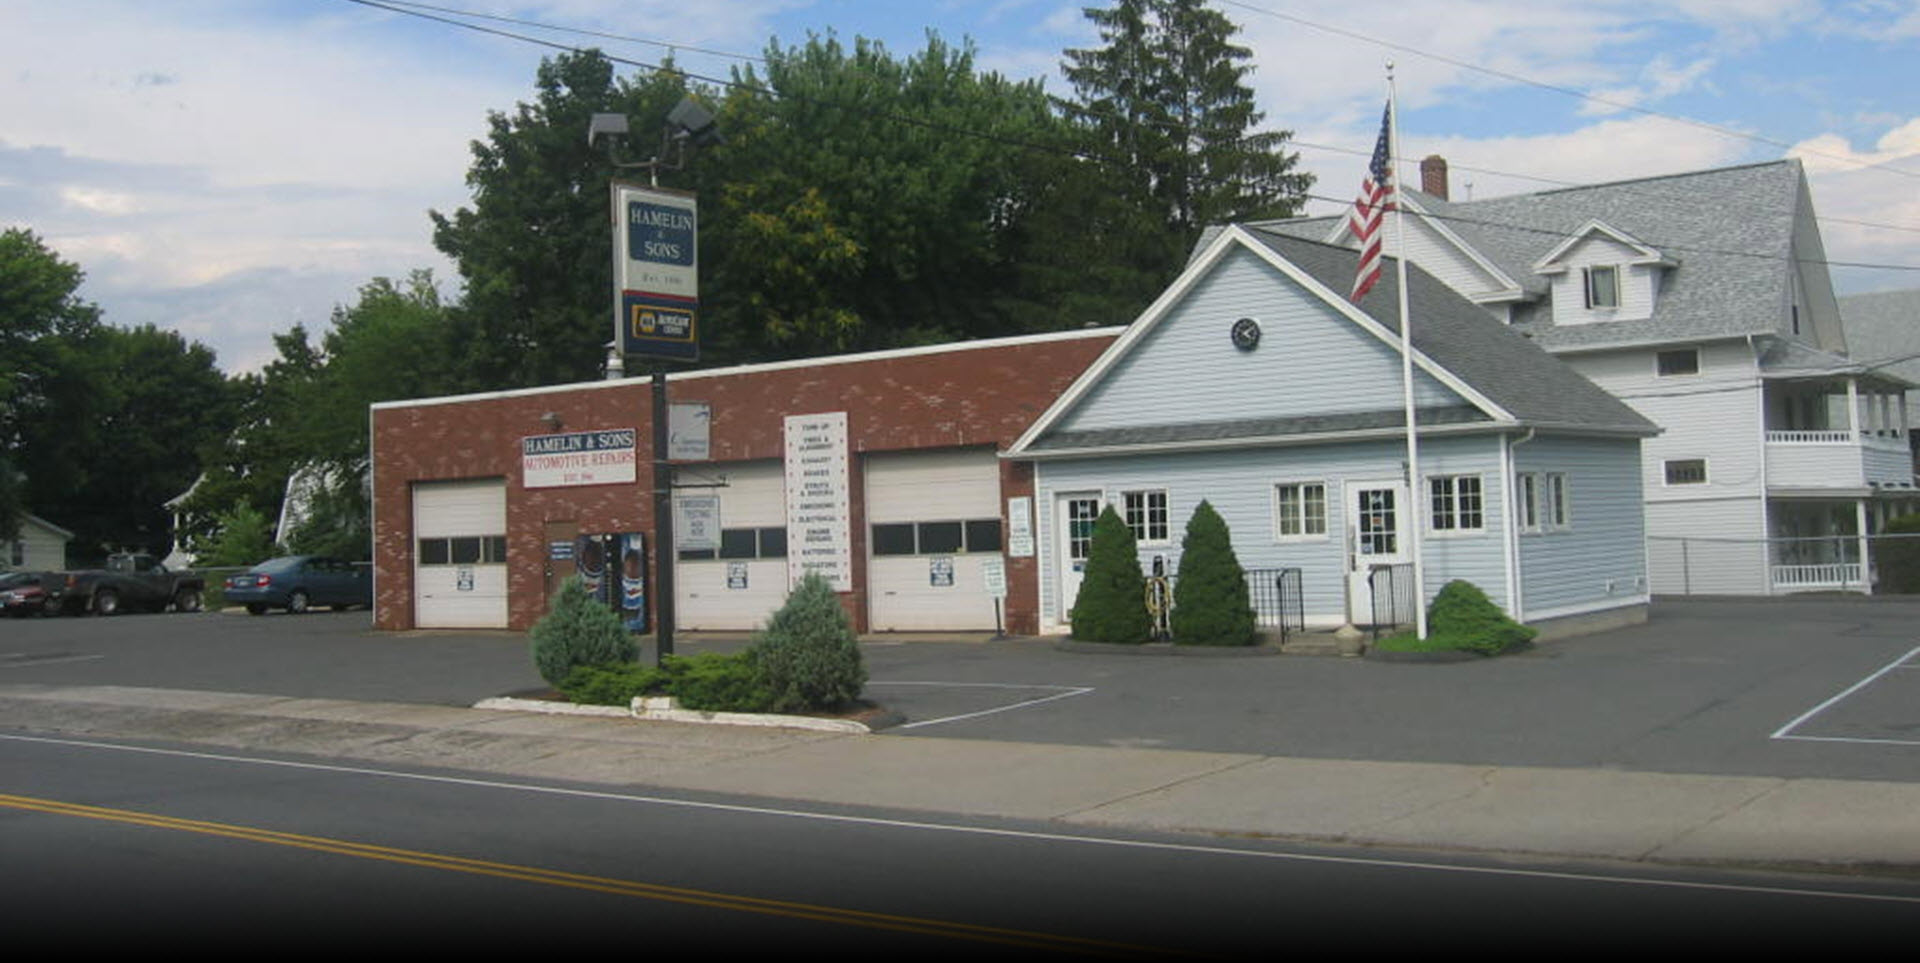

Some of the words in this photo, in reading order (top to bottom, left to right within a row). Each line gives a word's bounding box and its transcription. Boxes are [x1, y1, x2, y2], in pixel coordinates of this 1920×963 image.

[631, 208, 692, 231] HAMELIN
[644, 241, 681, 259] SONS
[525, 436, 582, 453] HAMELIN
[586, 435, 595, 450] &
[599, 432, 633, 448] SONS
[524, 453, 589, 471] AUTOMOTIVE
